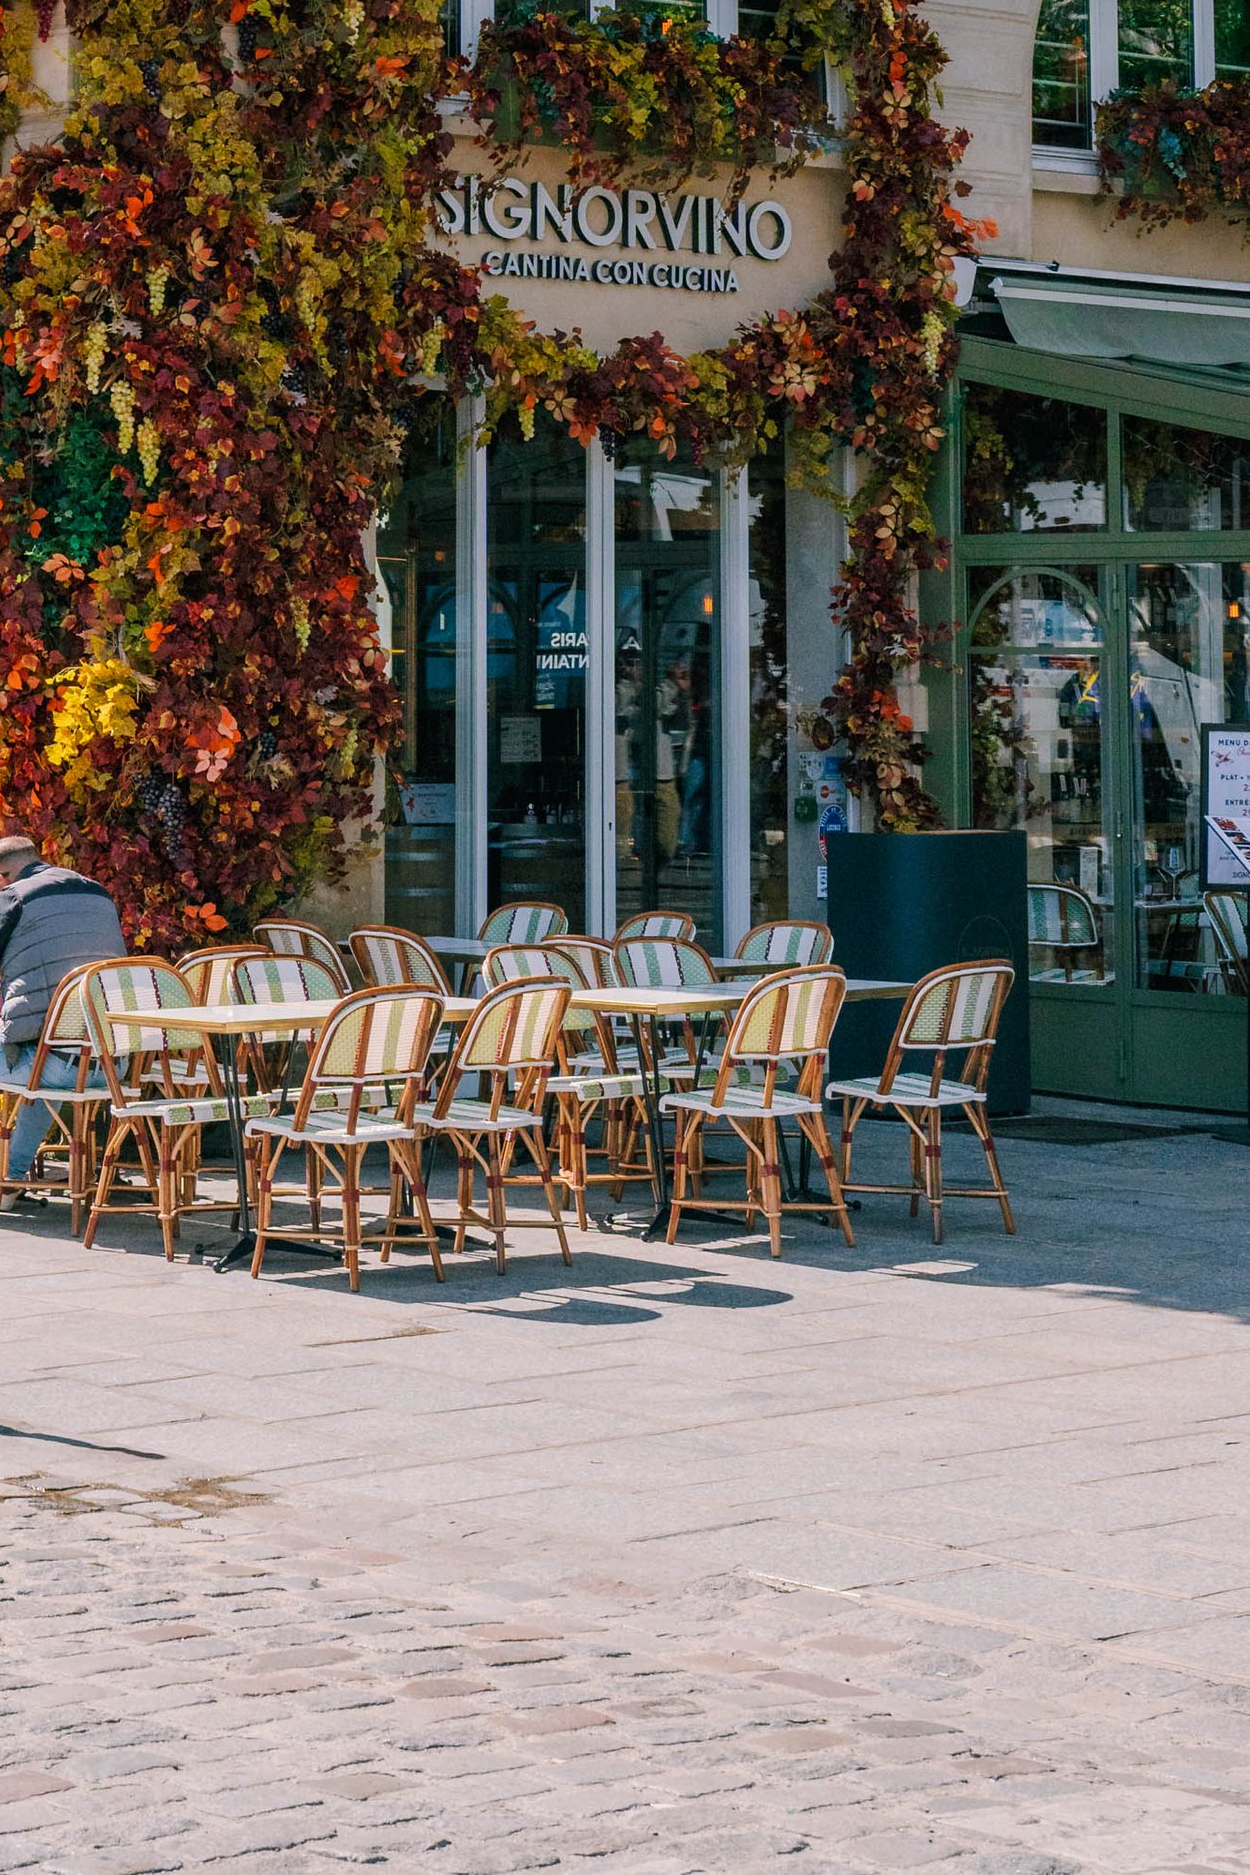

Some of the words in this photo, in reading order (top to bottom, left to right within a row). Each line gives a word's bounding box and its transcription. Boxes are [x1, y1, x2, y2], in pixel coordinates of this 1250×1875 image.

[436, 174, 792, 261] SIGNORVINO
[485, 251, 591, 282] CANTINA
[595, 258, 648, 286] CON
[653, 263, 740, 293] CUCINA
